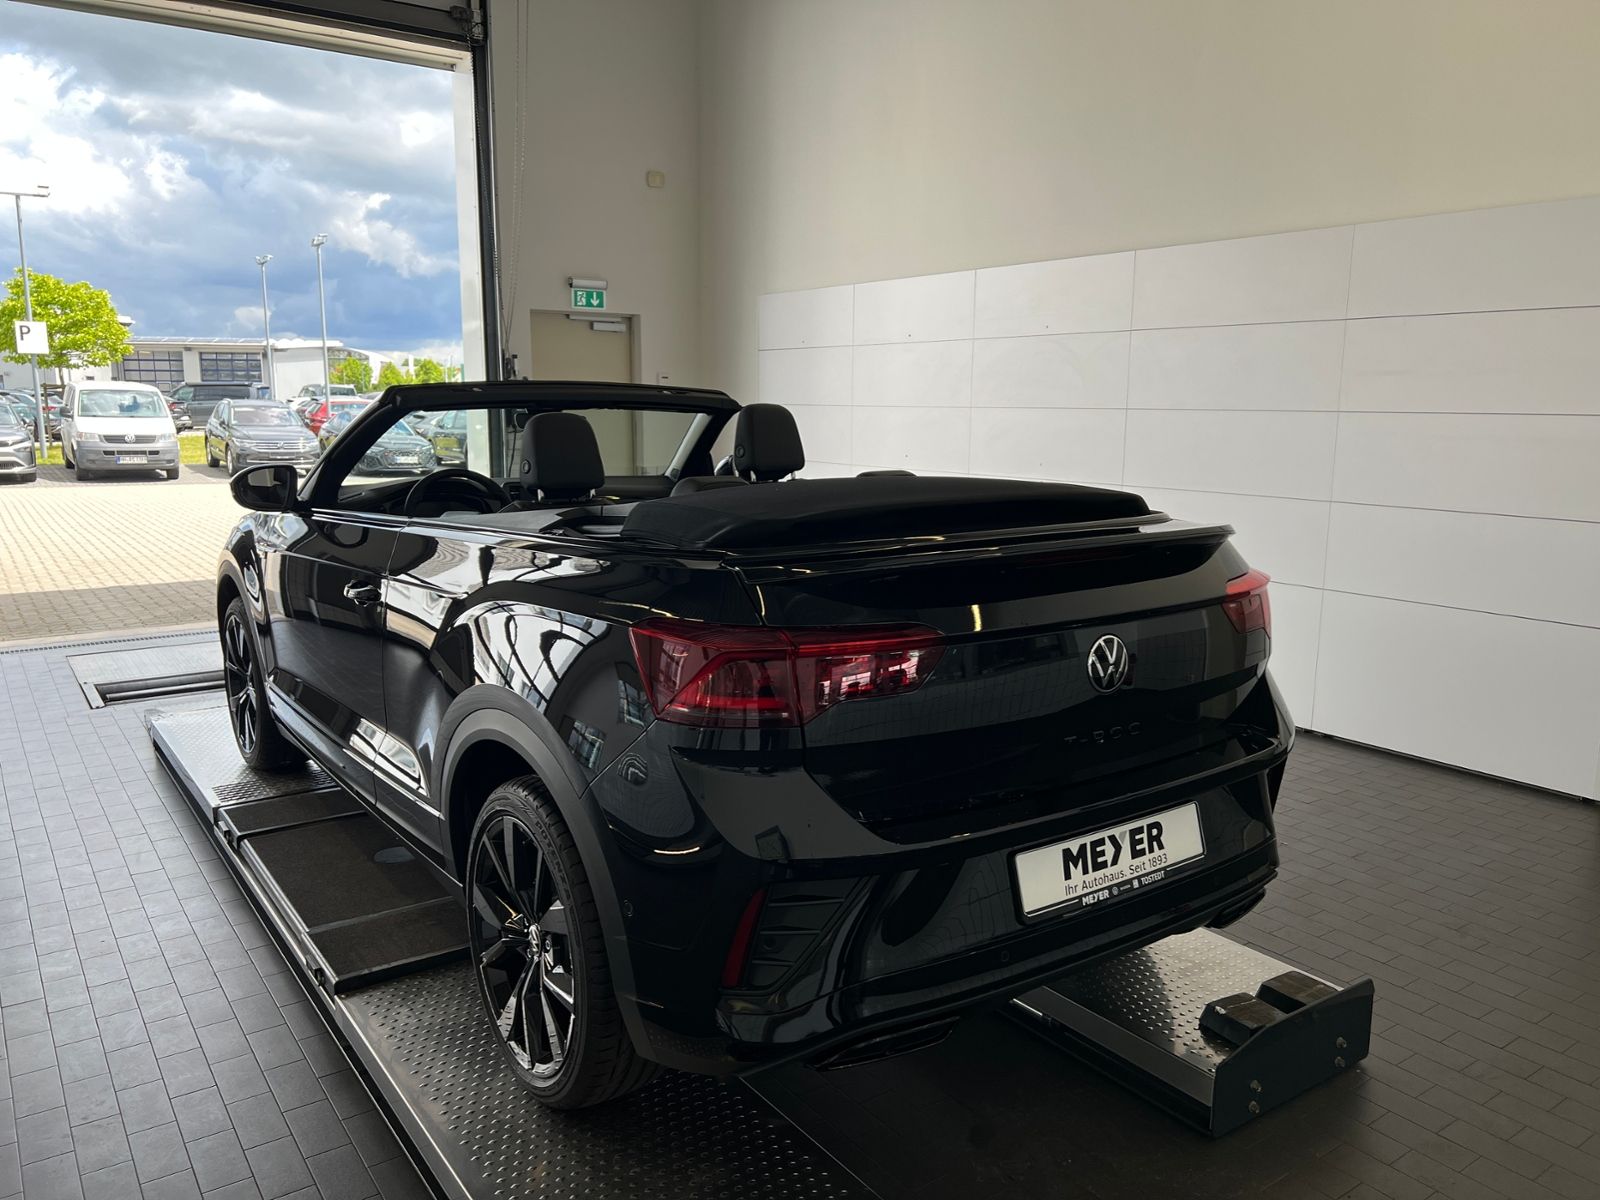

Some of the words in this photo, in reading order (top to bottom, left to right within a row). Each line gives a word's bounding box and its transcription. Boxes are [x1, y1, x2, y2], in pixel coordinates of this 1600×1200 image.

[19, 325, 31, 341] P
[1062, 822, 1165, 881] MEYER
[1065, 883, 1078, 896] Ihr
[1081, 871, 1127, 891] Autohaus.
[1129, 862, 1147, 875] Seit
[1148, 853, 1167, 870] 1893
[1082, 890, 1110, 906] MEYER
[1140, 871, 1165, 886] TOSTEDT
